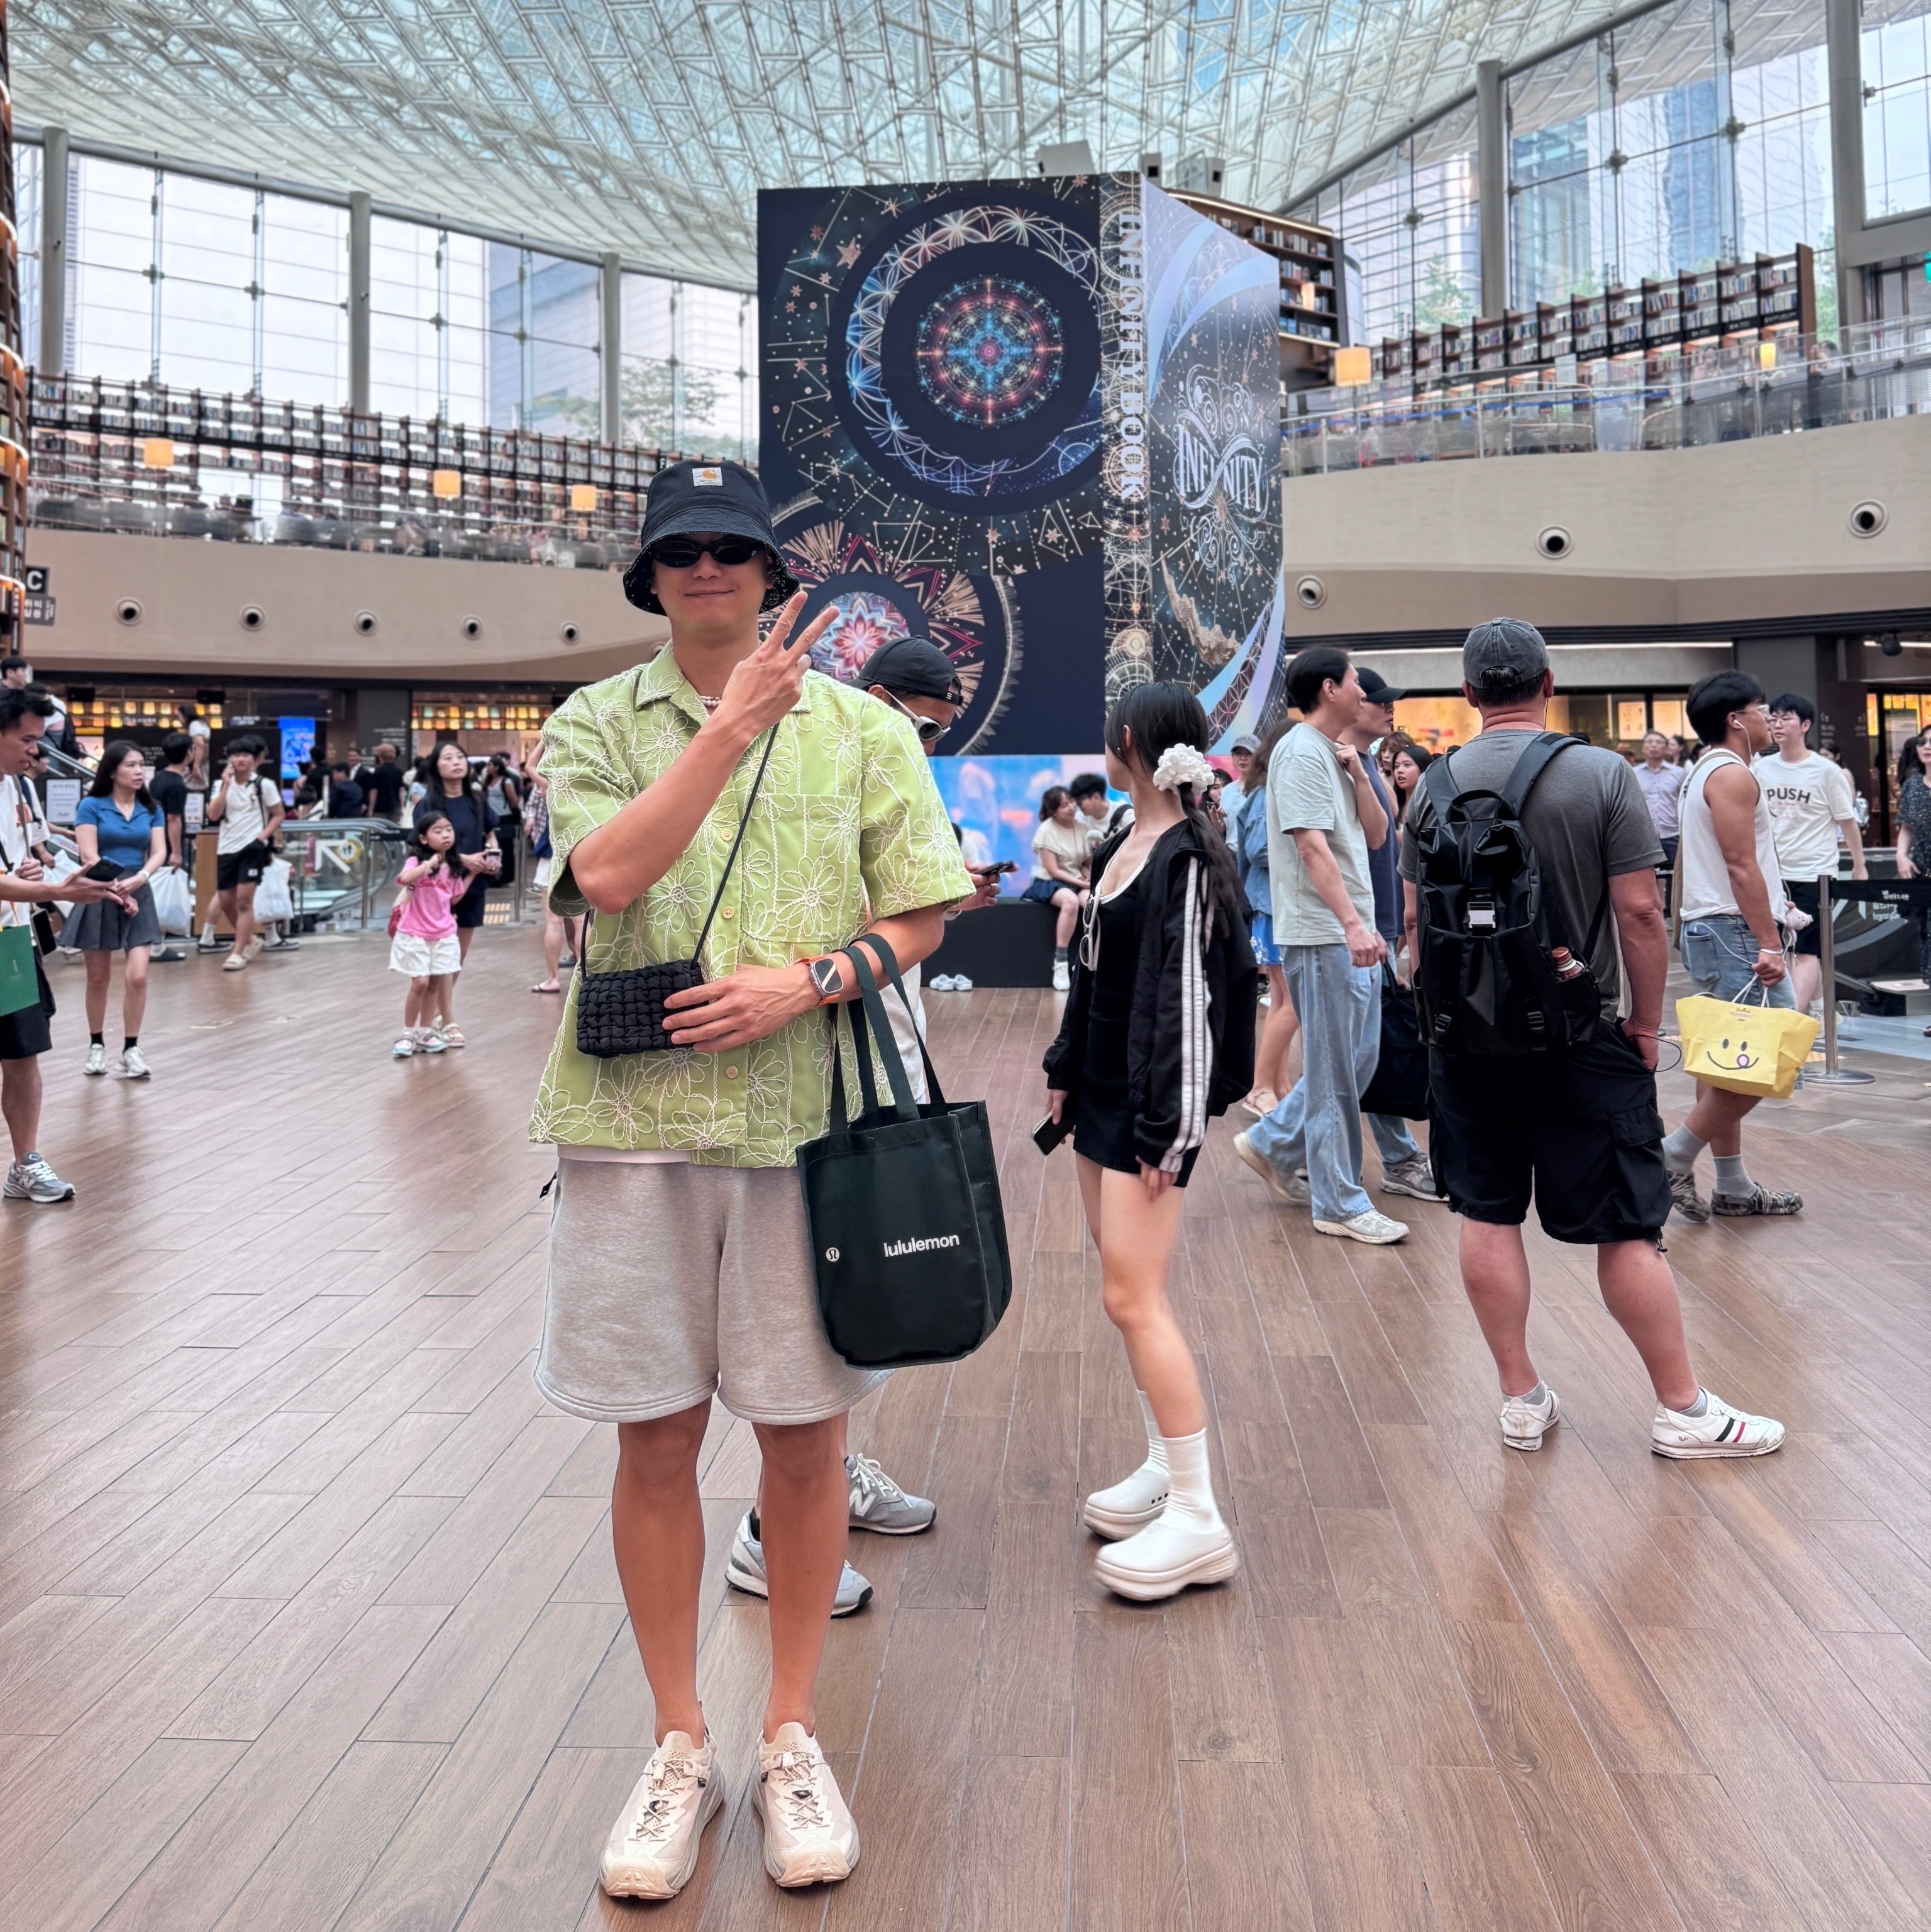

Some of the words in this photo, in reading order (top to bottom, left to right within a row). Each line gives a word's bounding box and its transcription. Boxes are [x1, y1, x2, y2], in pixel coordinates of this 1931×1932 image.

[1119, 213, 1144, 385] INFINITY
[1120, 392, 1145, 500] BOOK
[1177, 423, 1264, 513] INFINITY
[27, 570, 43, 590] C
[1766, 787, 1810, 804] PUSH
[883, 1233, 960, 1257] lululemon
